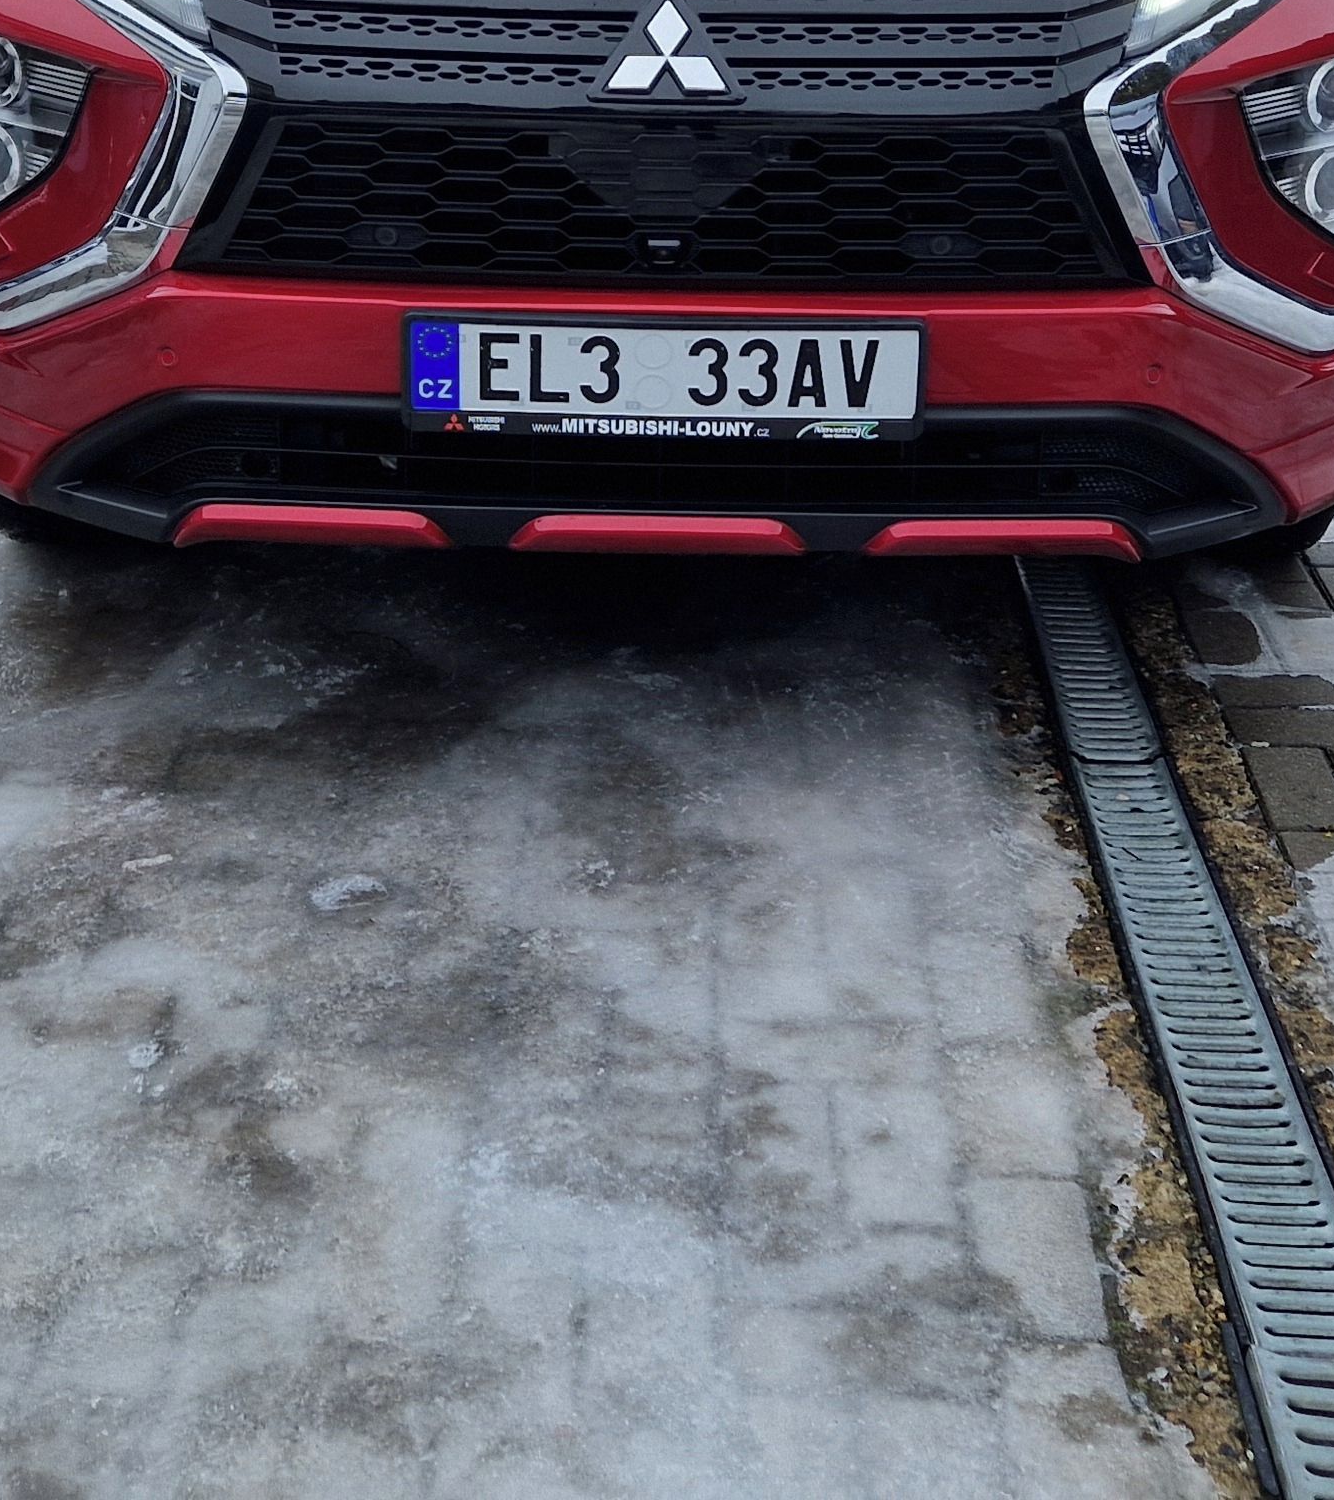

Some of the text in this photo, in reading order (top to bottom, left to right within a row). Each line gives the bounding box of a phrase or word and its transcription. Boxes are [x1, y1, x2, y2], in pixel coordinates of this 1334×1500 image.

[479, 332, 880, 408] EL3 33AV
[418, 378, 453, 399] CZ
[532, 417, 770, 438] www.MITSUBISHI-LOUNY.cz
